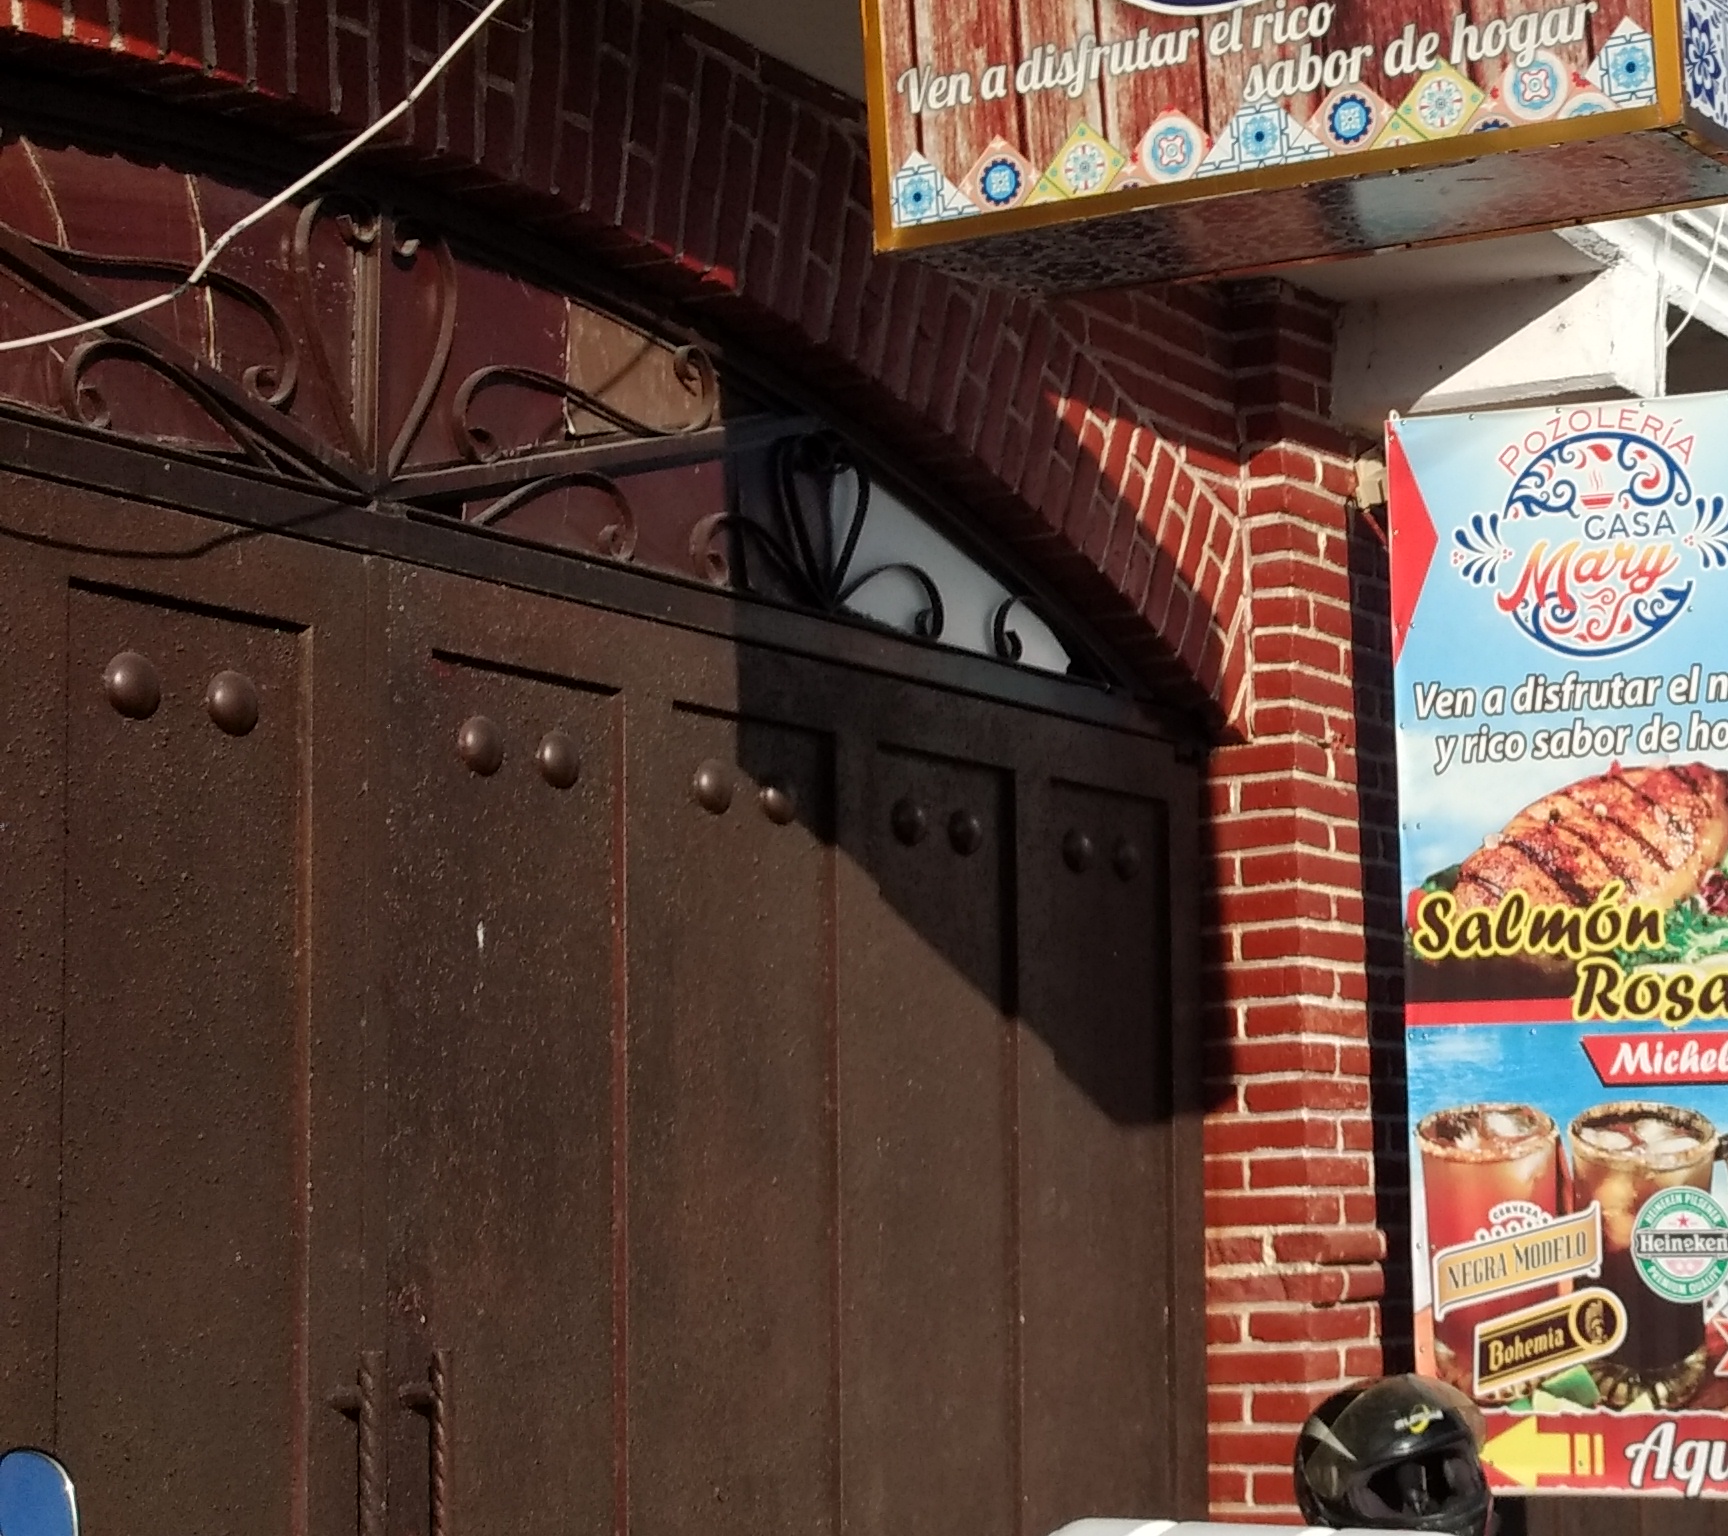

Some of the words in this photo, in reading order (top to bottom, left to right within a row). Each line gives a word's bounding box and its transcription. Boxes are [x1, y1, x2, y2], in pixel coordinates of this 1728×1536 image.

[897, 66, 972, 113] Ven
[980, 65, 1007, 100] a
[1015, 27, 1200, 99] disfrutar
[1208, 8, 1244, 56] el
[1243, 36, 1374, 103] sabor
[1383, 23, 1439, 77] de
[1450, 0, 1598, 68] hogar
[1499, 408, 1694, 477] POZOLERÍA
[1584, 510, 1676, 541] CASA
[1497, 540, 1679, 611] Mary
[1414, 682, 1474, 720] Ven
[1483, 684, 1505, 716] a
[1512, 671, 1661, 714] disfrutar
[1669, 663, 1698, 704] el
[1435, 734, 1465, 775] y
[1463, 724, 1526, 763] rico
[1531, 718, 1632, 759] sabor
[1637, 713, 1680, 752] de
[1417, 883, 1662, 956] Salmón
[1492, 1203, 1539, 1220] CERVEZA
[1448, 1252, 1508, 1289] NEGRA
[1513, 1230, 1587, 1273] MODELO
[1488, 1326, 1565, 1371] Bohemia
